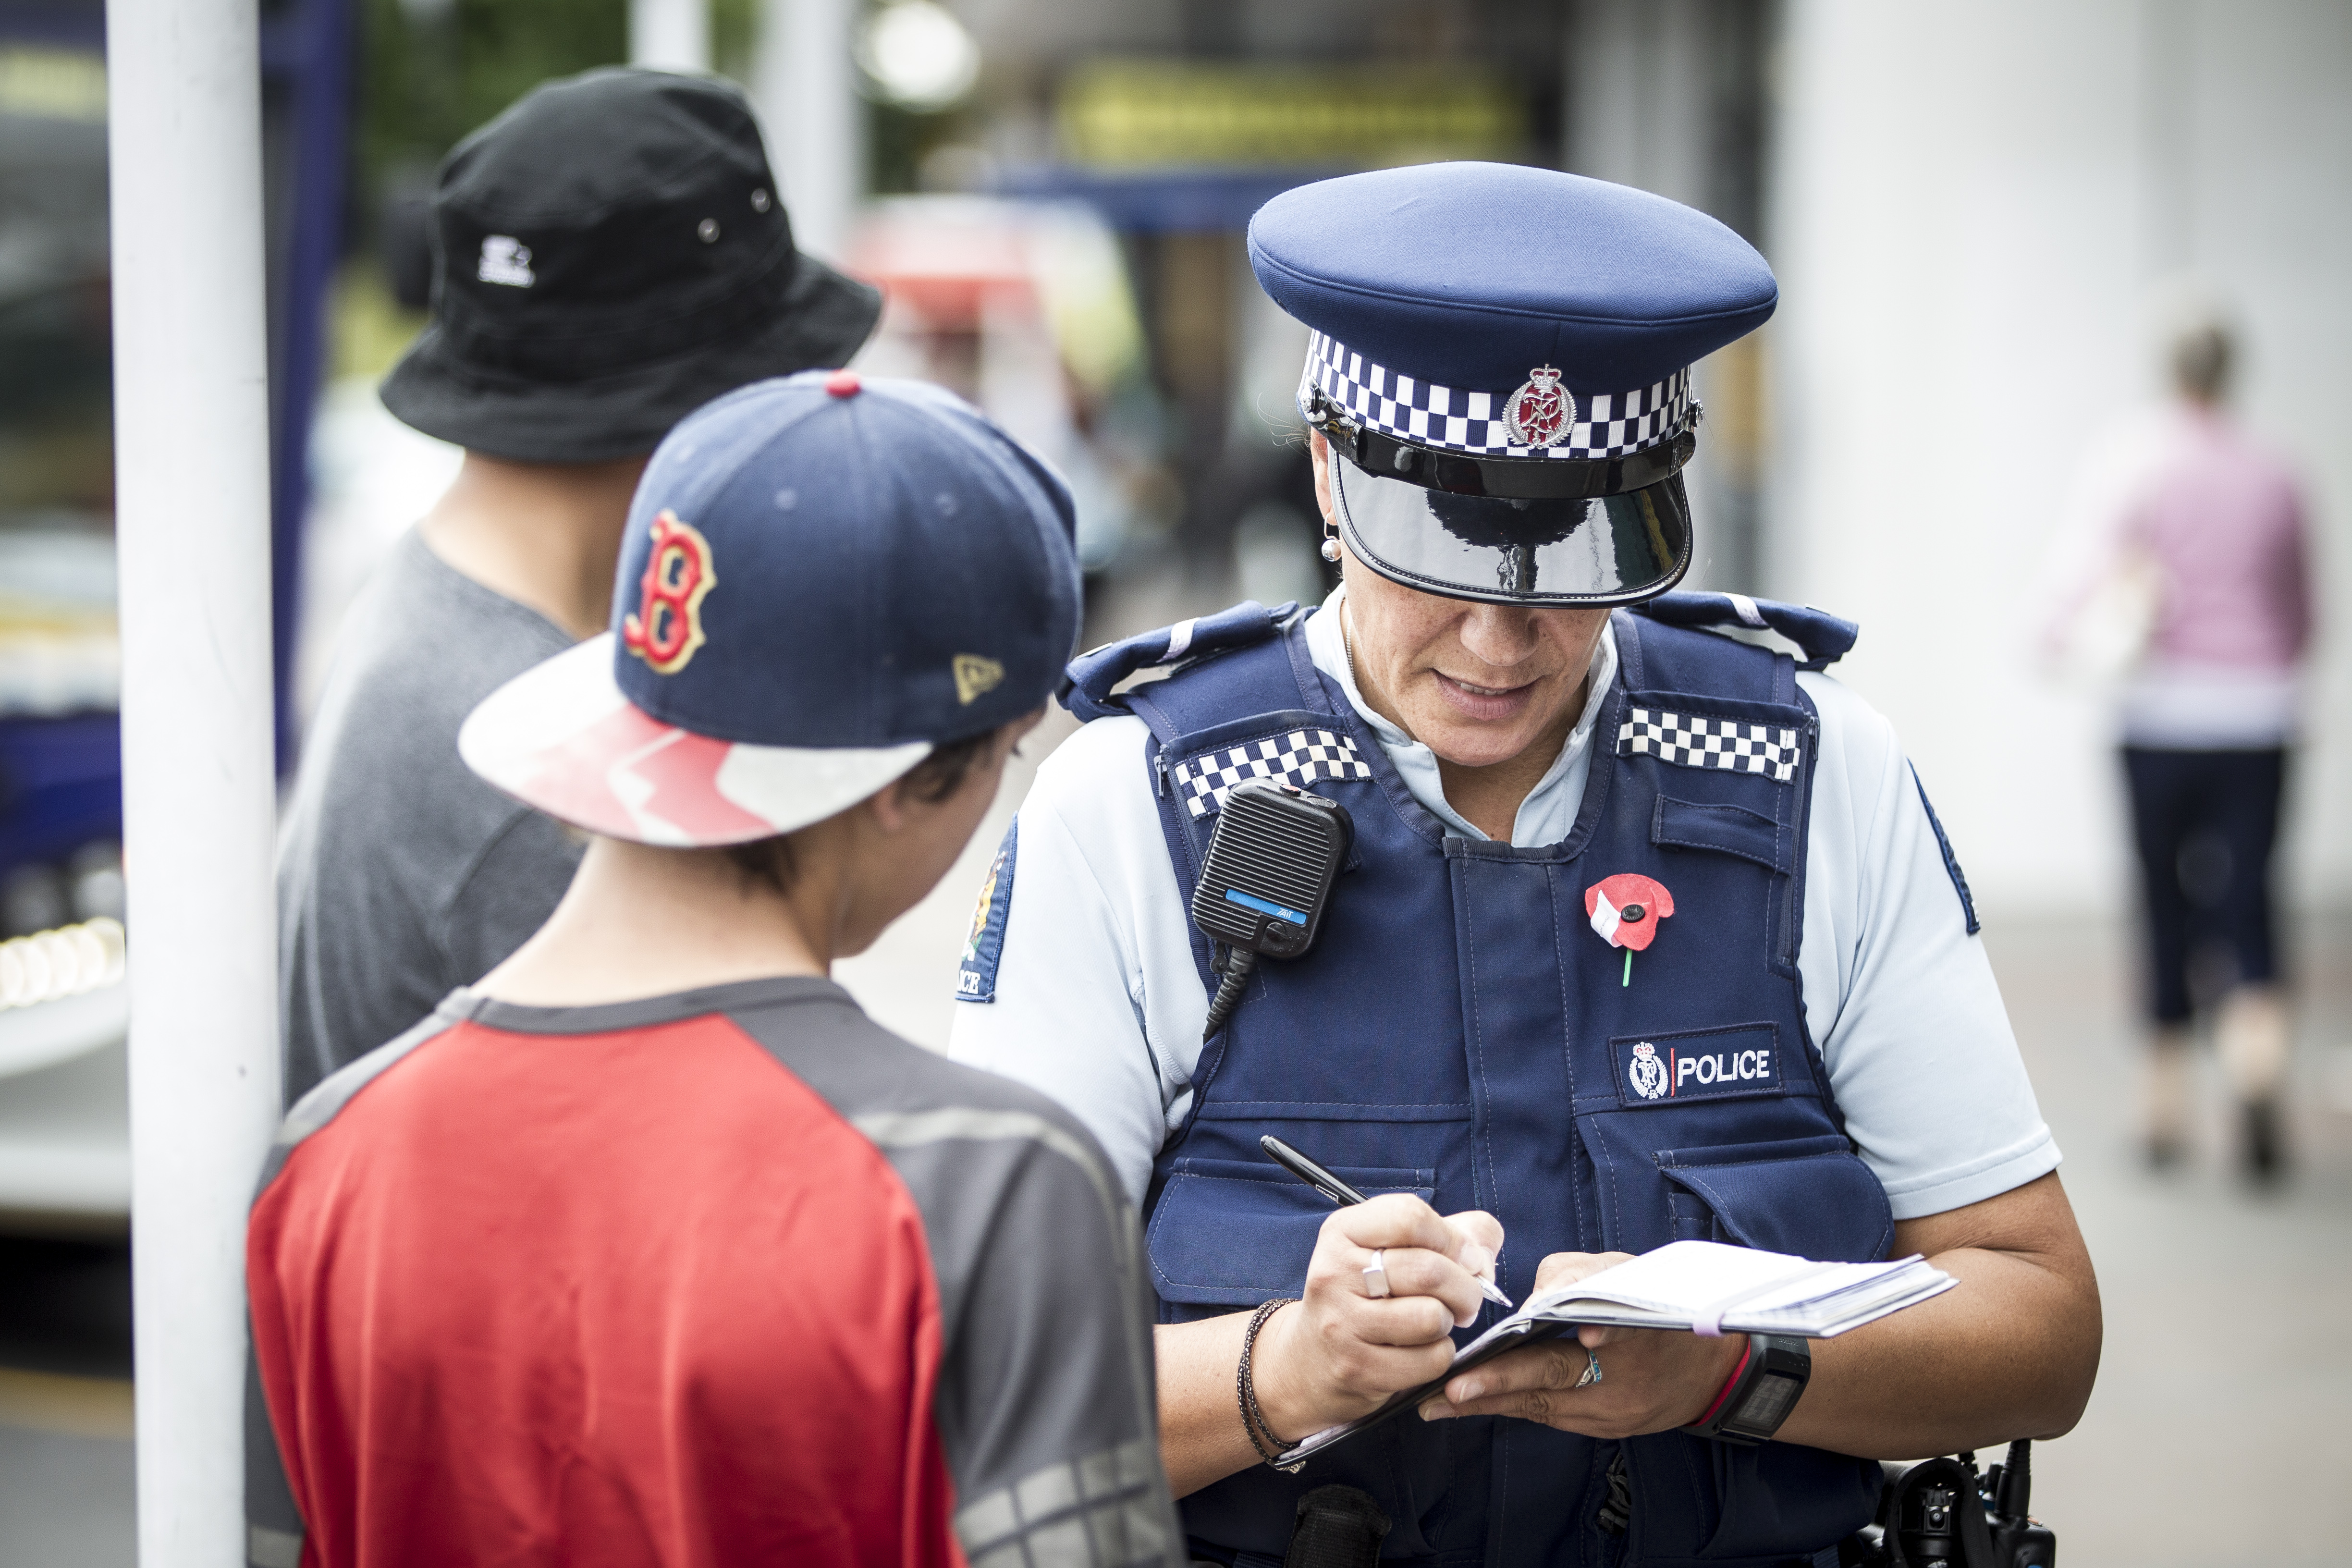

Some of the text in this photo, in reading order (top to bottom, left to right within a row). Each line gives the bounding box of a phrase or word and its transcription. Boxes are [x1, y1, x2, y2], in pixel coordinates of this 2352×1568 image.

[623, 507, 718, 676] B
[1276, 907, 1294, 919] TAIT
[957, 969, 981, 994] ICE
[1677, 1050, 1769, 1087] POLICE
